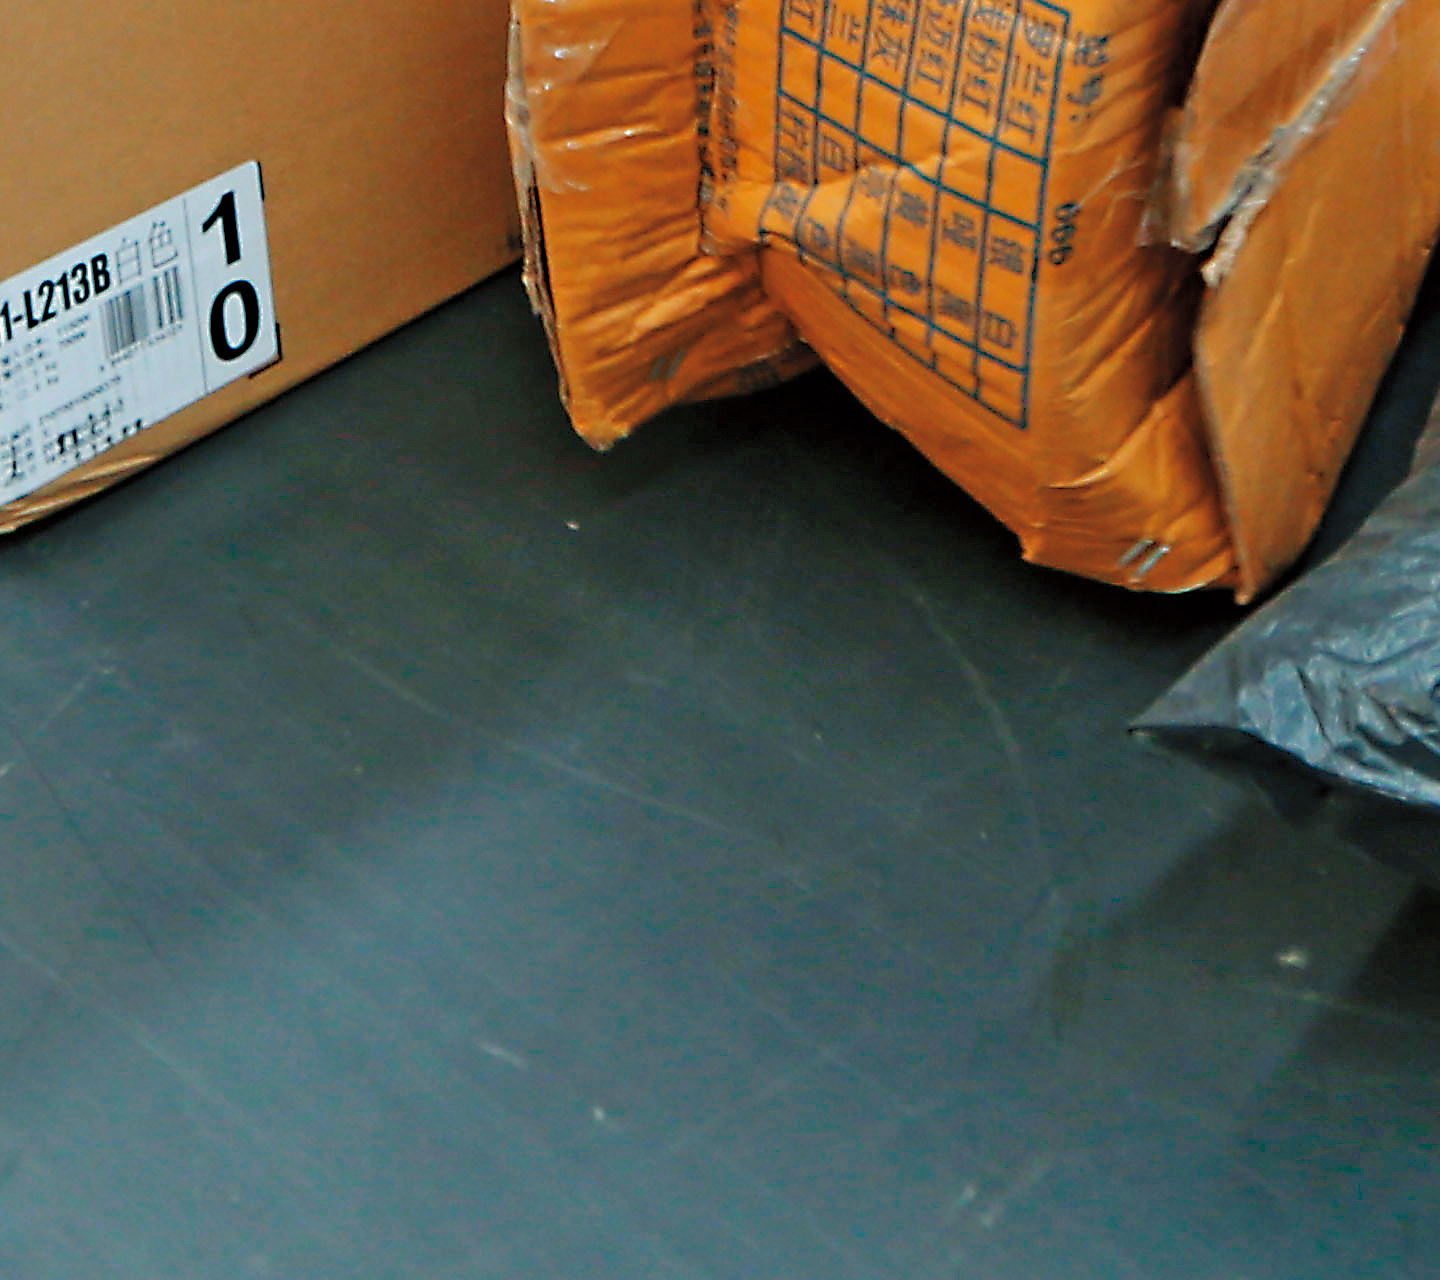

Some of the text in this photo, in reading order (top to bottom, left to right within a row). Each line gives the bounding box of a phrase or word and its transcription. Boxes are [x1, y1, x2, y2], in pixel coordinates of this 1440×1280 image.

[114, 221, 179, 285] 白色
[201, 190, 242, 267] 1
[209, 279, 261, 361] 0
